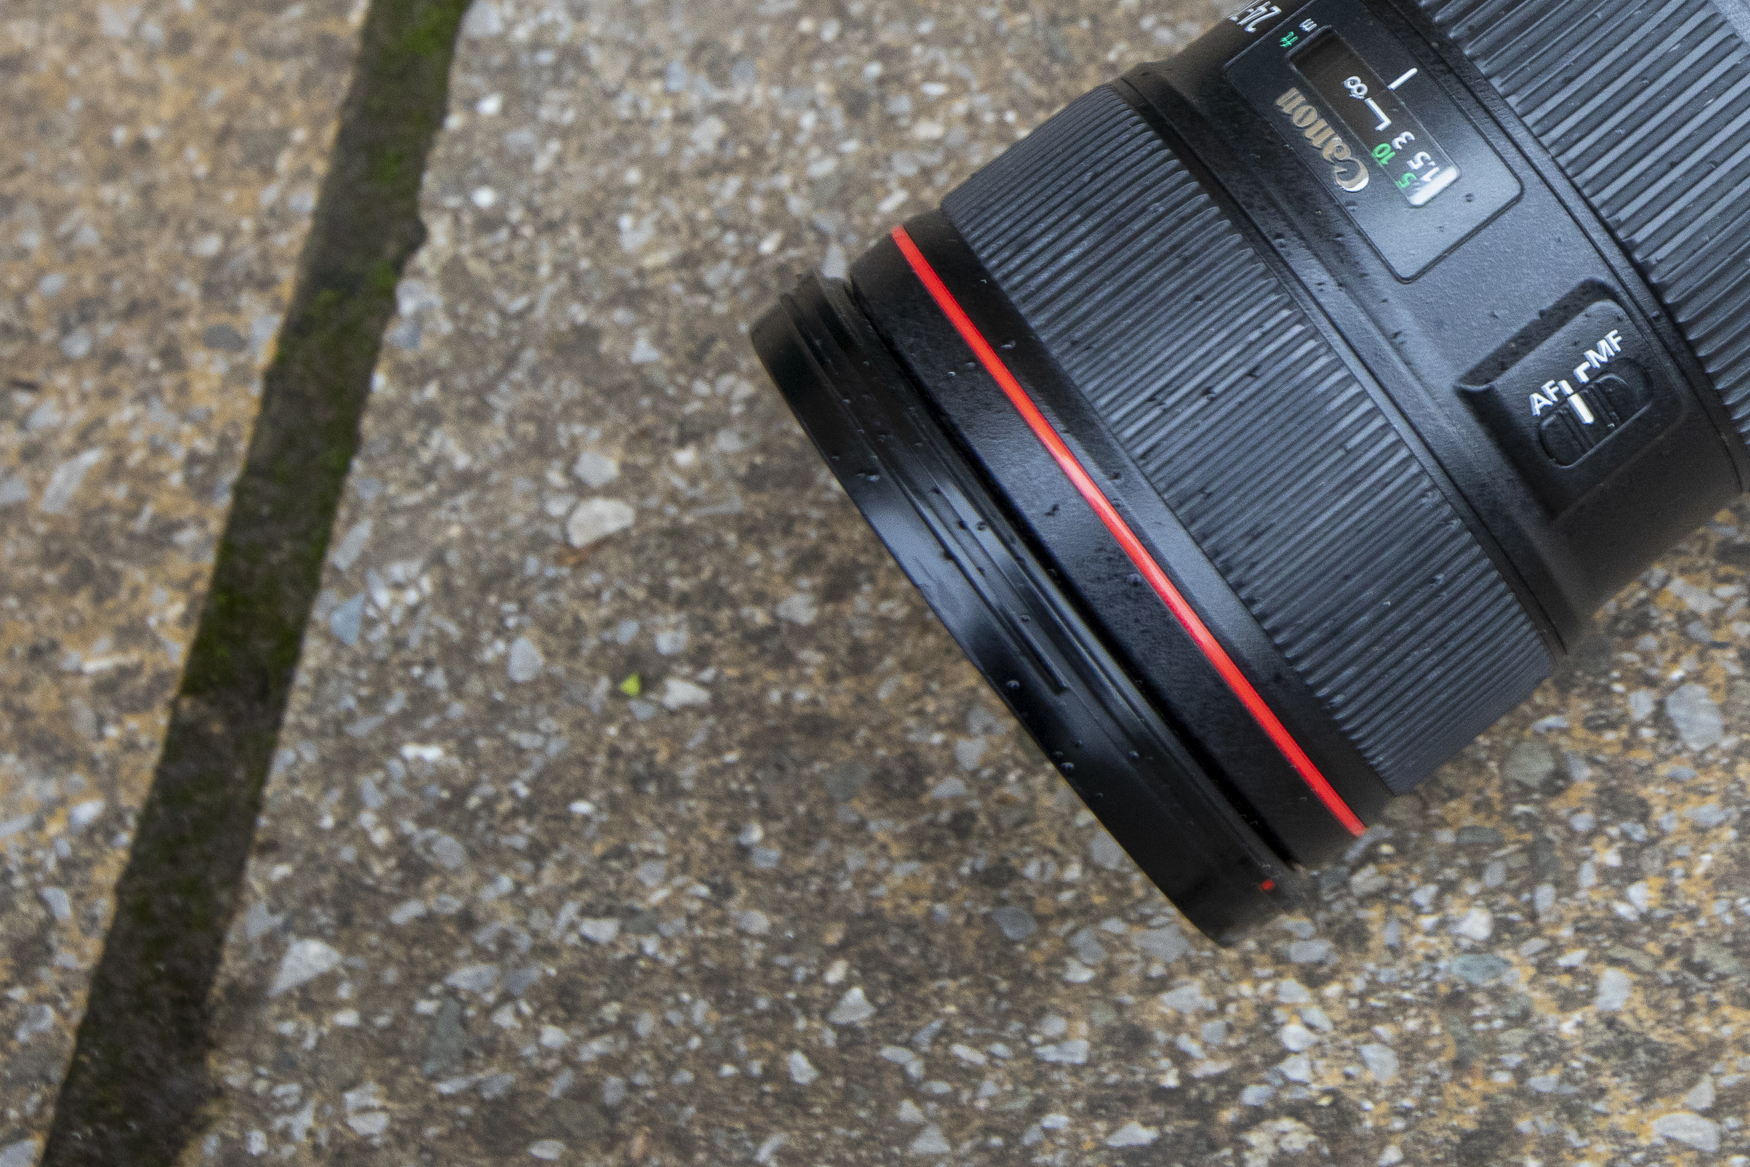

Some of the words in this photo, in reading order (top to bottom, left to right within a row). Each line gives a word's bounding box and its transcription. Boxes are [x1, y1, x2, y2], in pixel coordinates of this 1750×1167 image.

[1299, 18, 1317, 33] m
[1279, 31, 1299, 48] ft
[1274, 86, 1370, 192] Canon
[1391, 131, 1416, 150] 3
[1371, 142, 1396, 166] 10
[1395, 172, 1417, 189] 5
[1583, 329, 1622, 369] MF
[1529, 380, 1560, 416] AF
